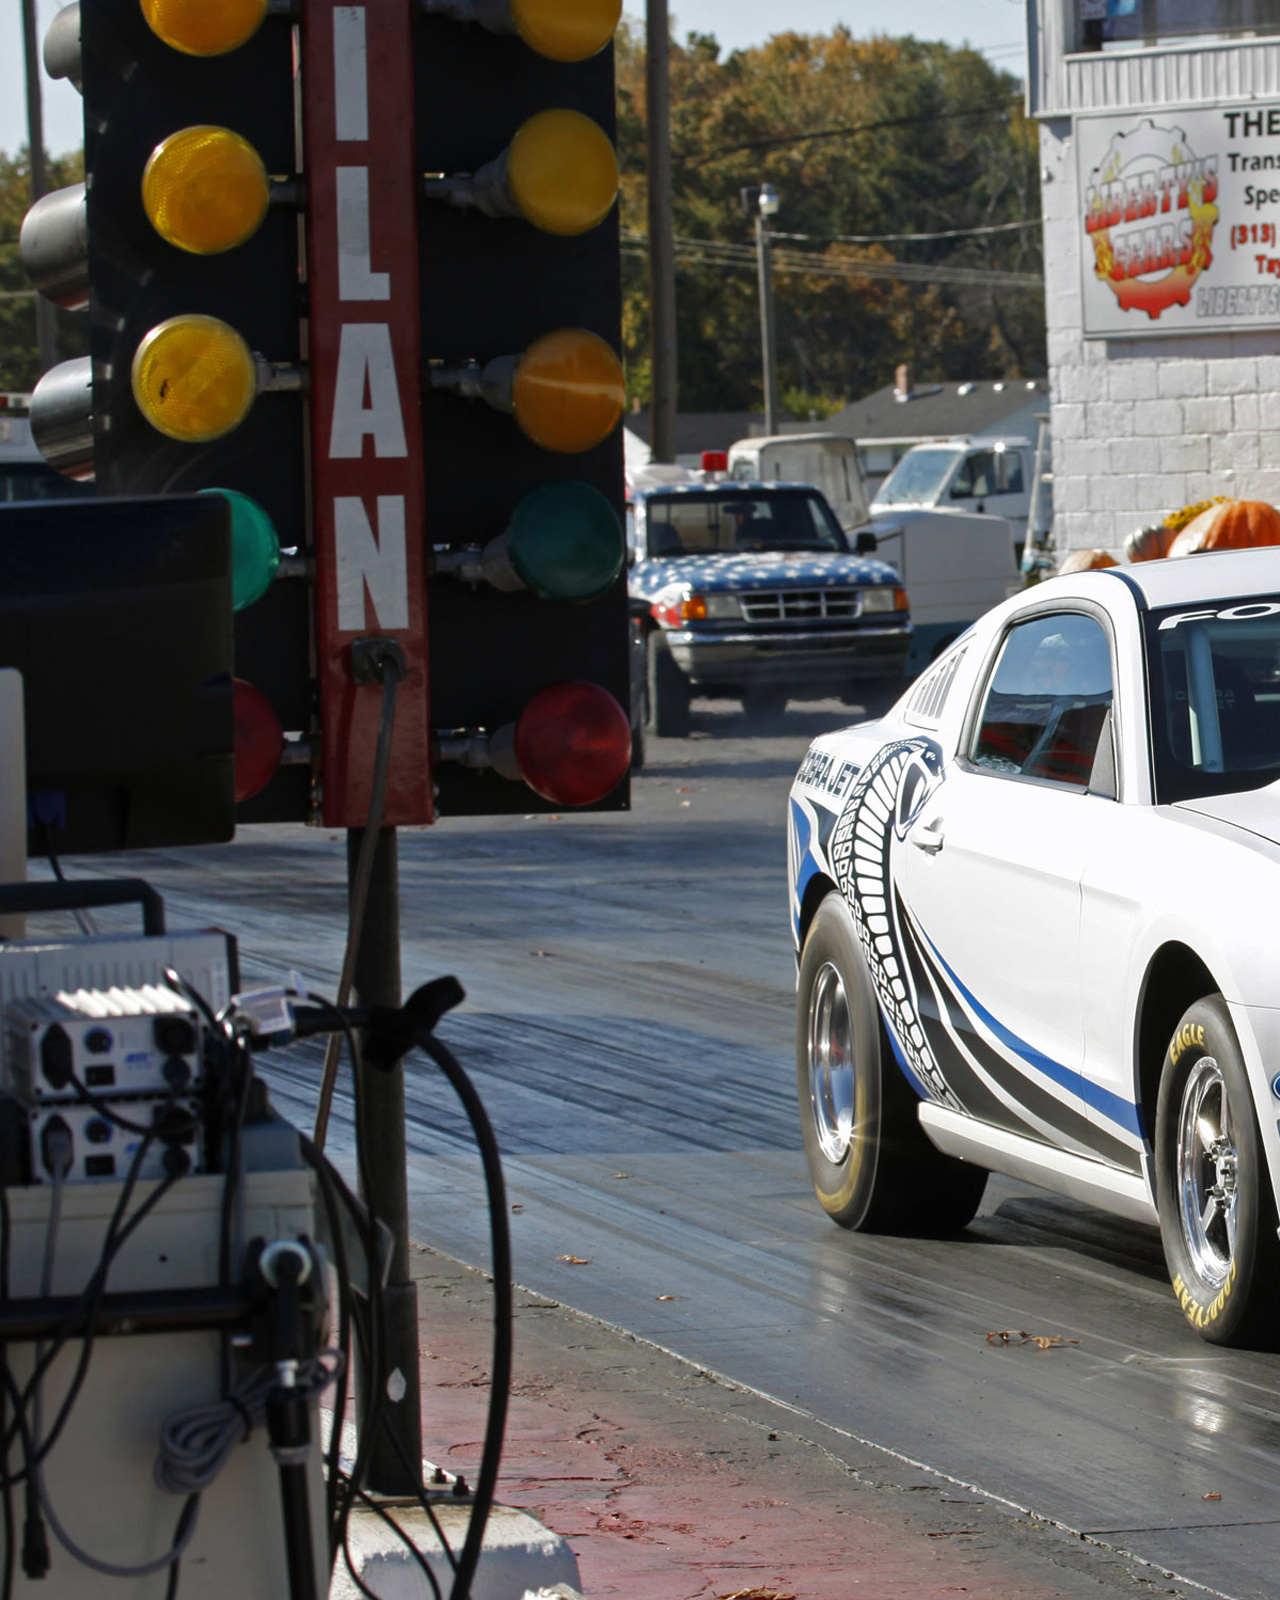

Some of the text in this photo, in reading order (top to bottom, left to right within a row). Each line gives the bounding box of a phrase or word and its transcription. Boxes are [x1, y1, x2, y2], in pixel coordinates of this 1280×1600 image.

[1230, 222, 1276, 250] (313)
[827, 760, 862, 800] JET
[1169, 1024, 1205, 1066] EAGLE
[1173, 1256, 1236, 1329] GOODYEAR
